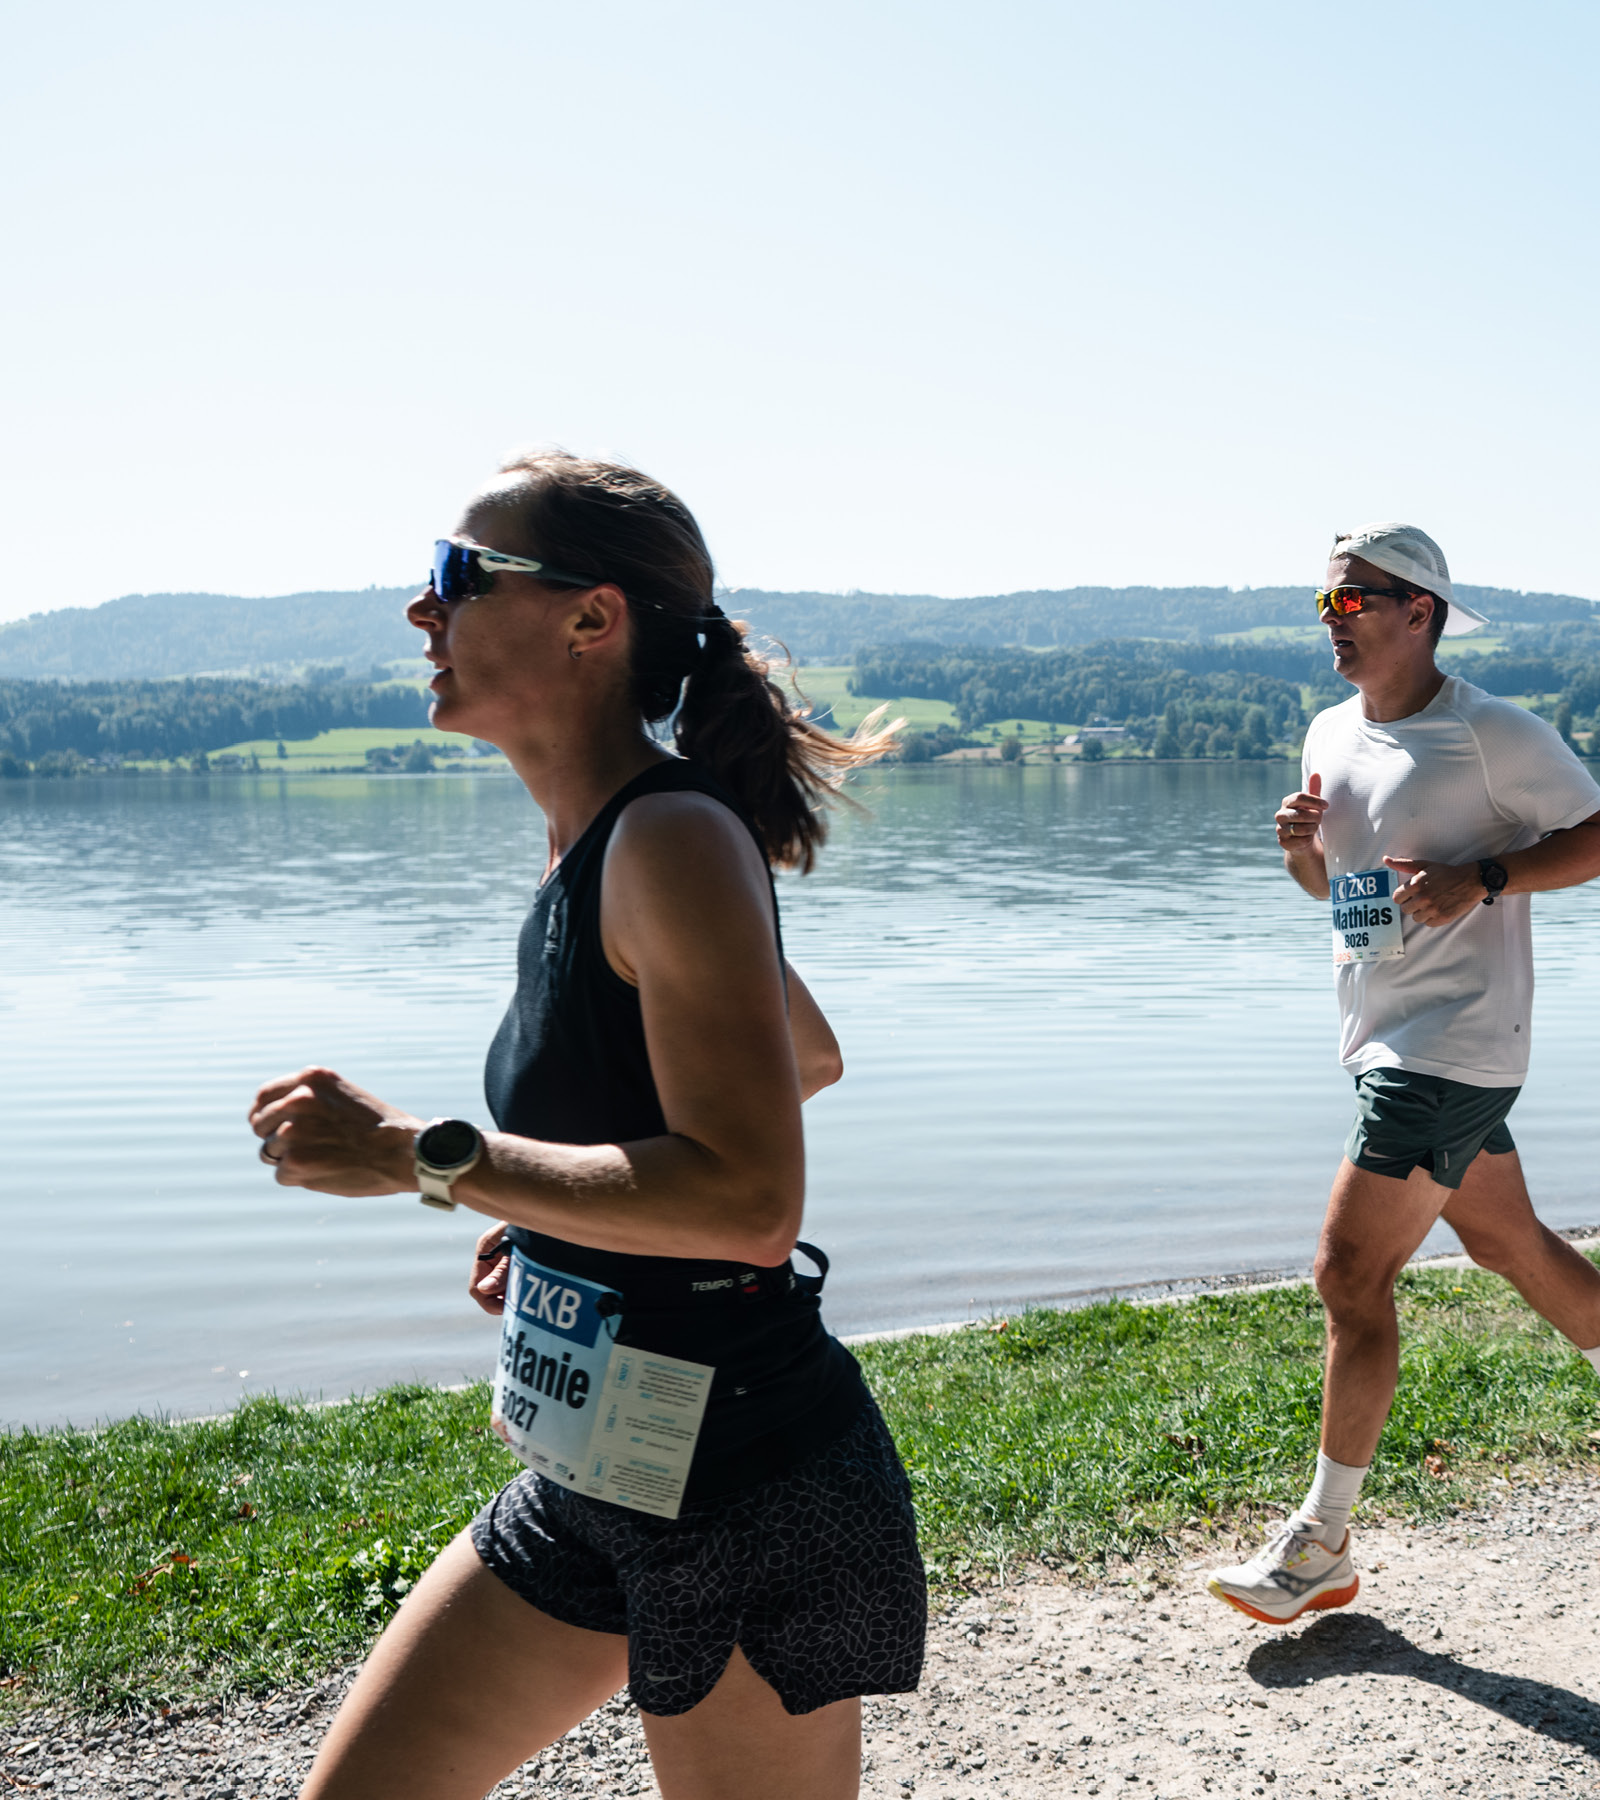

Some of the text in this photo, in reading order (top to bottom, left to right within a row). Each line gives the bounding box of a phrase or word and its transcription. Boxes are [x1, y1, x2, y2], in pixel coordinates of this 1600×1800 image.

[1348, 876, 1377, 898] ZKB
[1333, 904, 1393, 931] Mathias
[1344, 932, 1369, 949] 8026
[691, 1278, 734, 1292] TEMPO
[520, 1273, 582, 1330] ZKB
[499, 1331, 590, 1409] efanie
